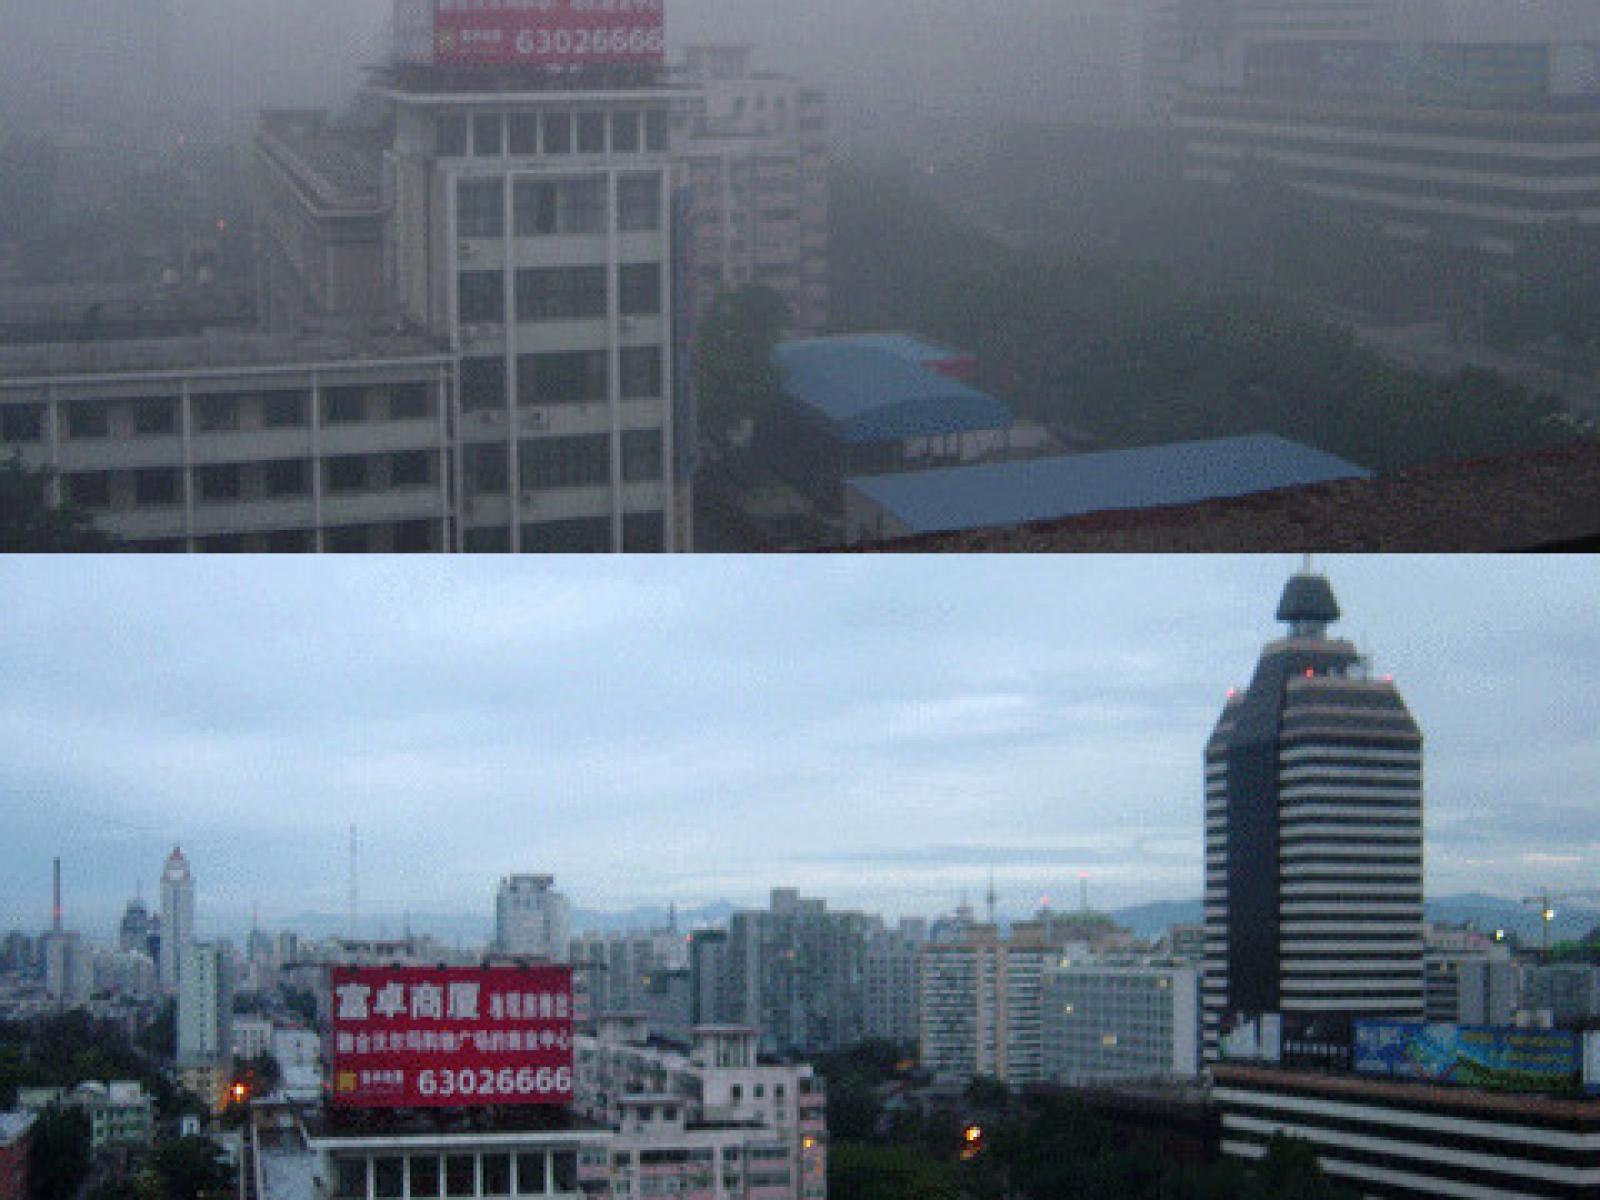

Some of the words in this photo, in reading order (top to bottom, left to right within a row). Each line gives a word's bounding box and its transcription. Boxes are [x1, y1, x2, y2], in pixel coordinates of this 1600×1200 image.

[516, 28, 665, 54] 63026666
[336, 982, 480, 1020] 富卓商厦
[418, 1067, 571, 1095] 63026666
